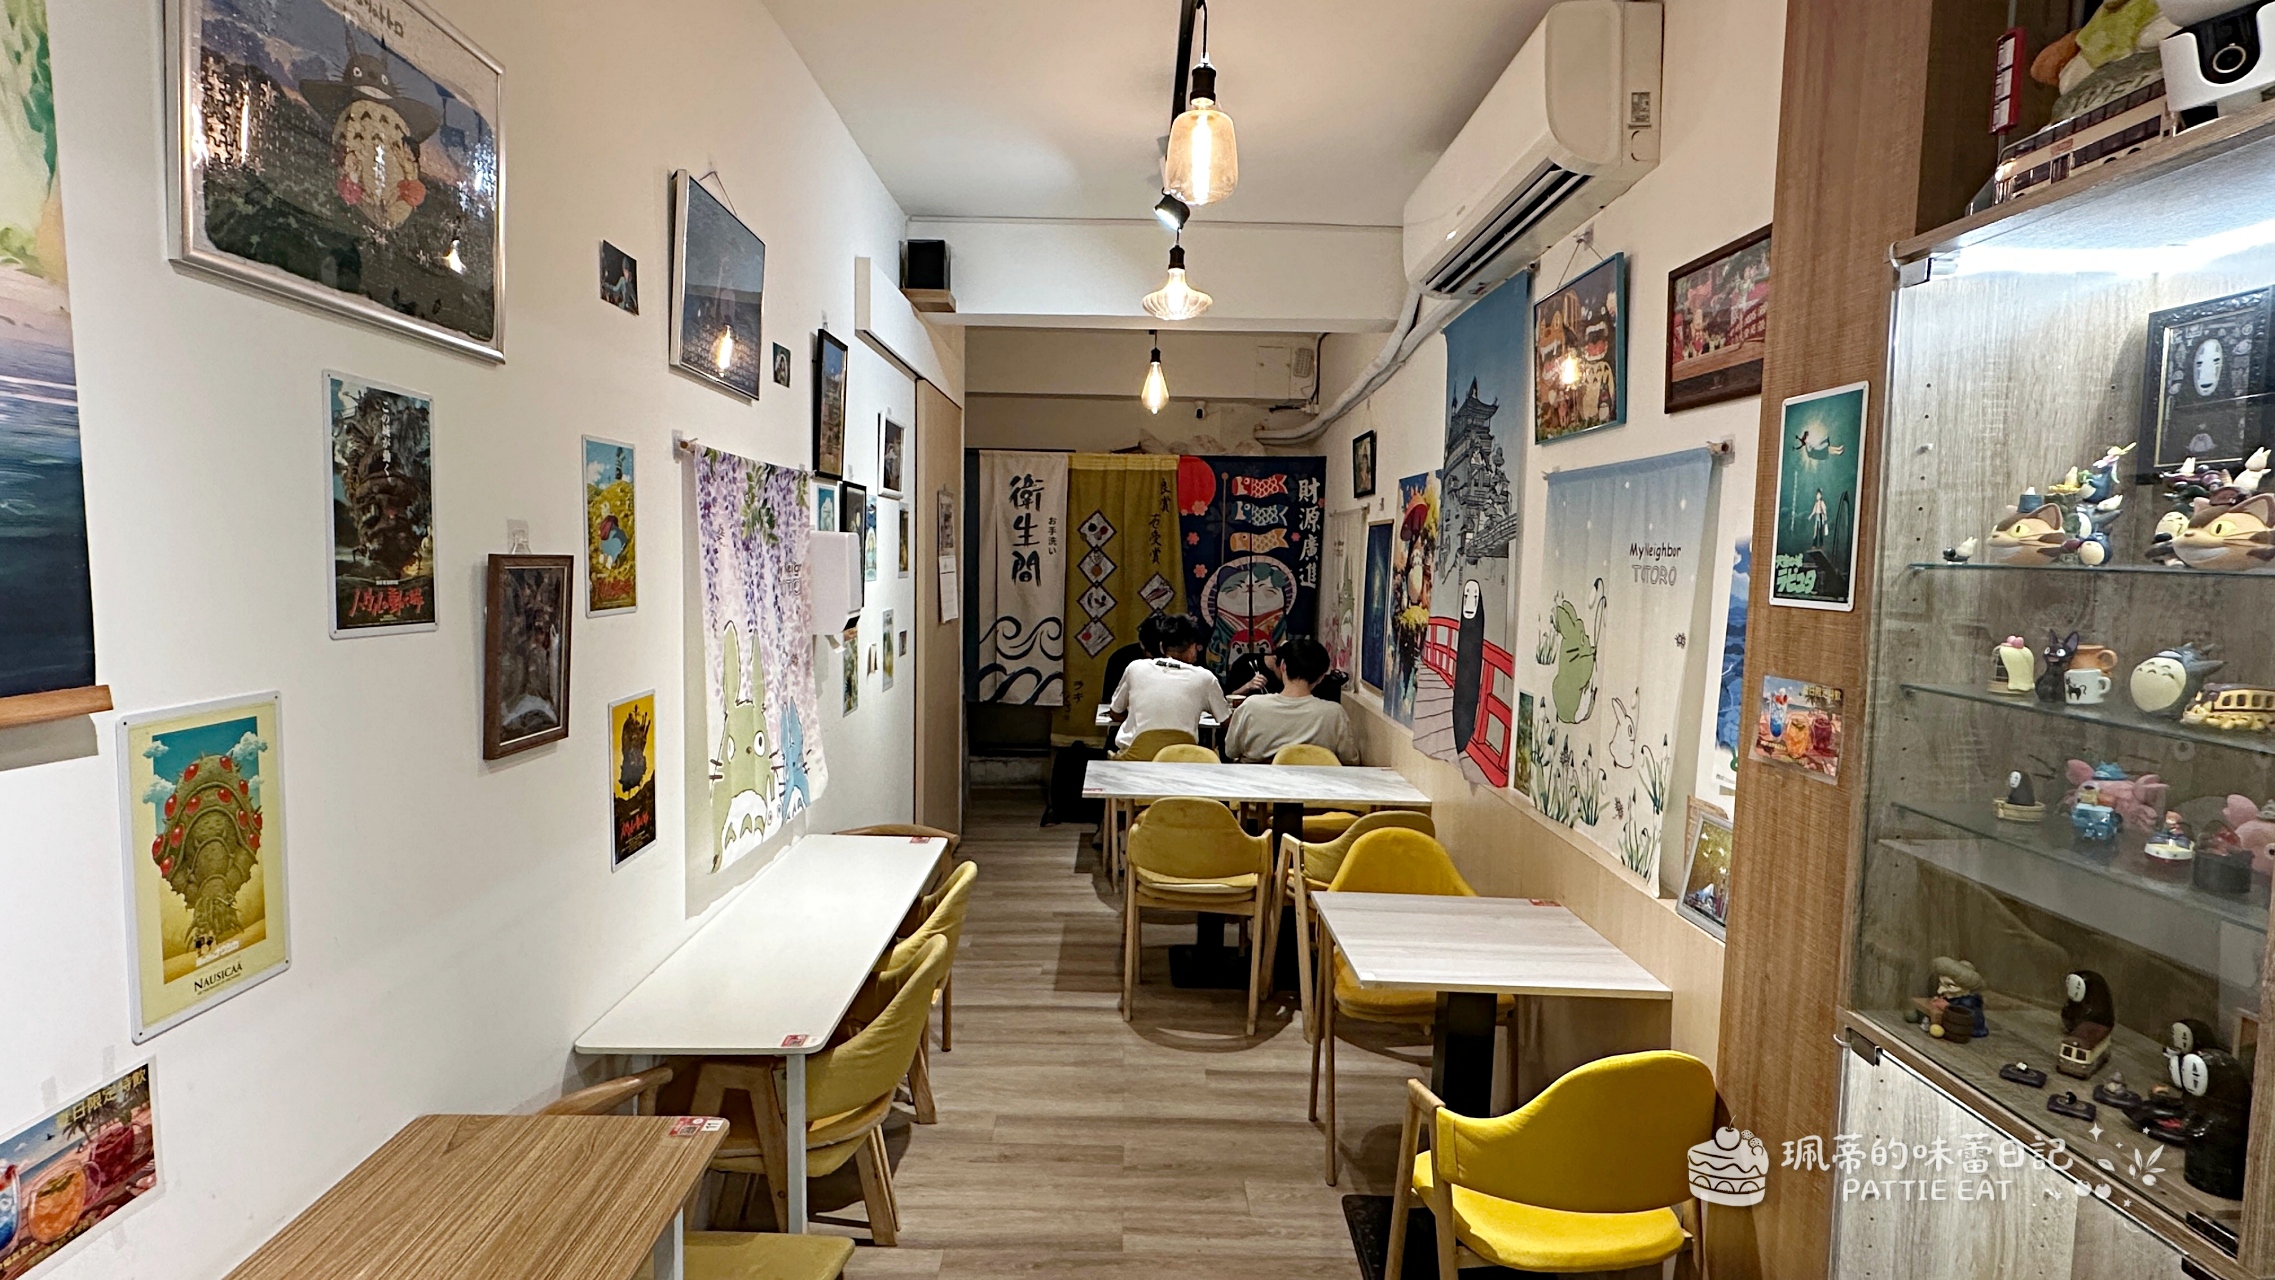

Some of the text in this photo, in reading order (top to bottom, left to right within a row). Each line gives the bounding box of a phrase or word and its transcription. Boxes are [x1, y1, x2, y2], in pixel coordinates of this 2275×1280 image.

[1009, 473, 1045, 587] 衛生間
[1048, 516, 1057, 555] お手洗い
[1299, 477, 1321, 589] 財源廣進
[1630, 541, 1681, 561] My Neighbor
